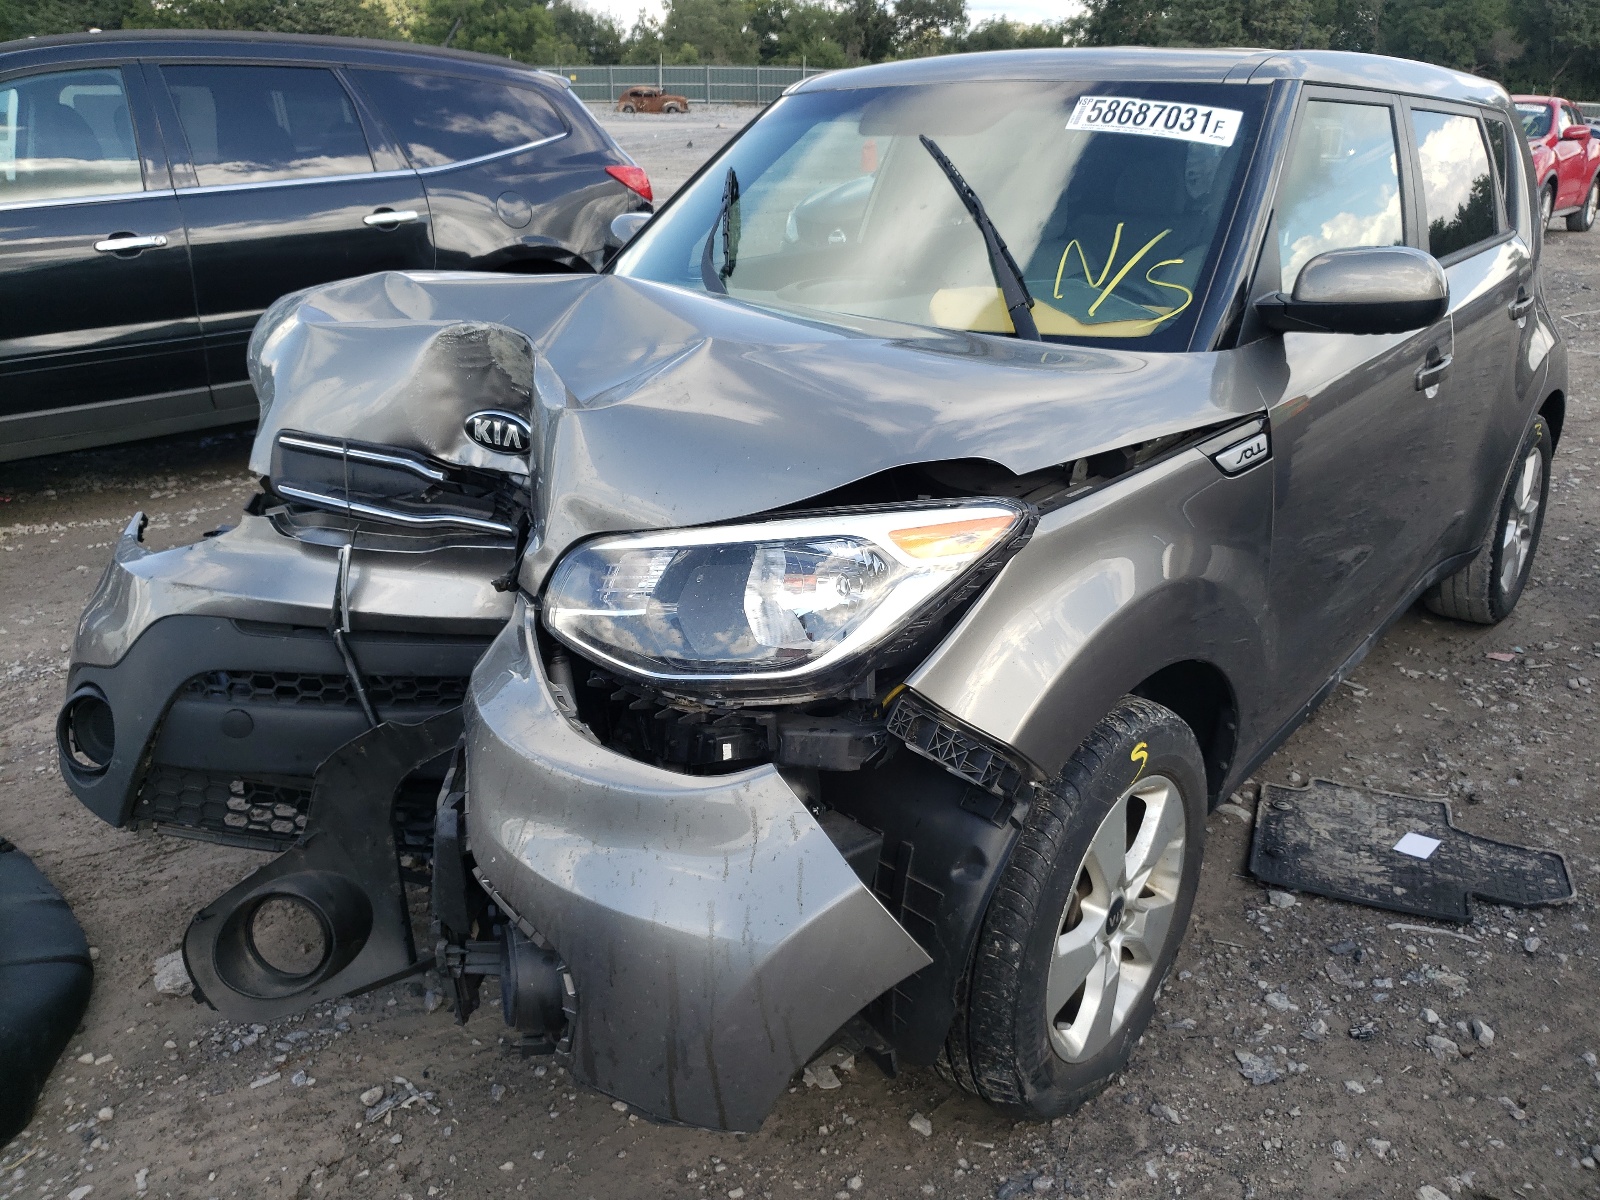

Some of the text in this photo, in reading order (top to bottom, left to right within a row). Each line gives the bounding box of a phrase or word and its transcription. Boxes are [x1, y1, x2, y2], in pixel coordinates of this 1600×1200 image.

[1086, 99, 1213, 135] 58687031
[1213, 120, 1226, 134] F
[474, 418, 522, 449] KIA
